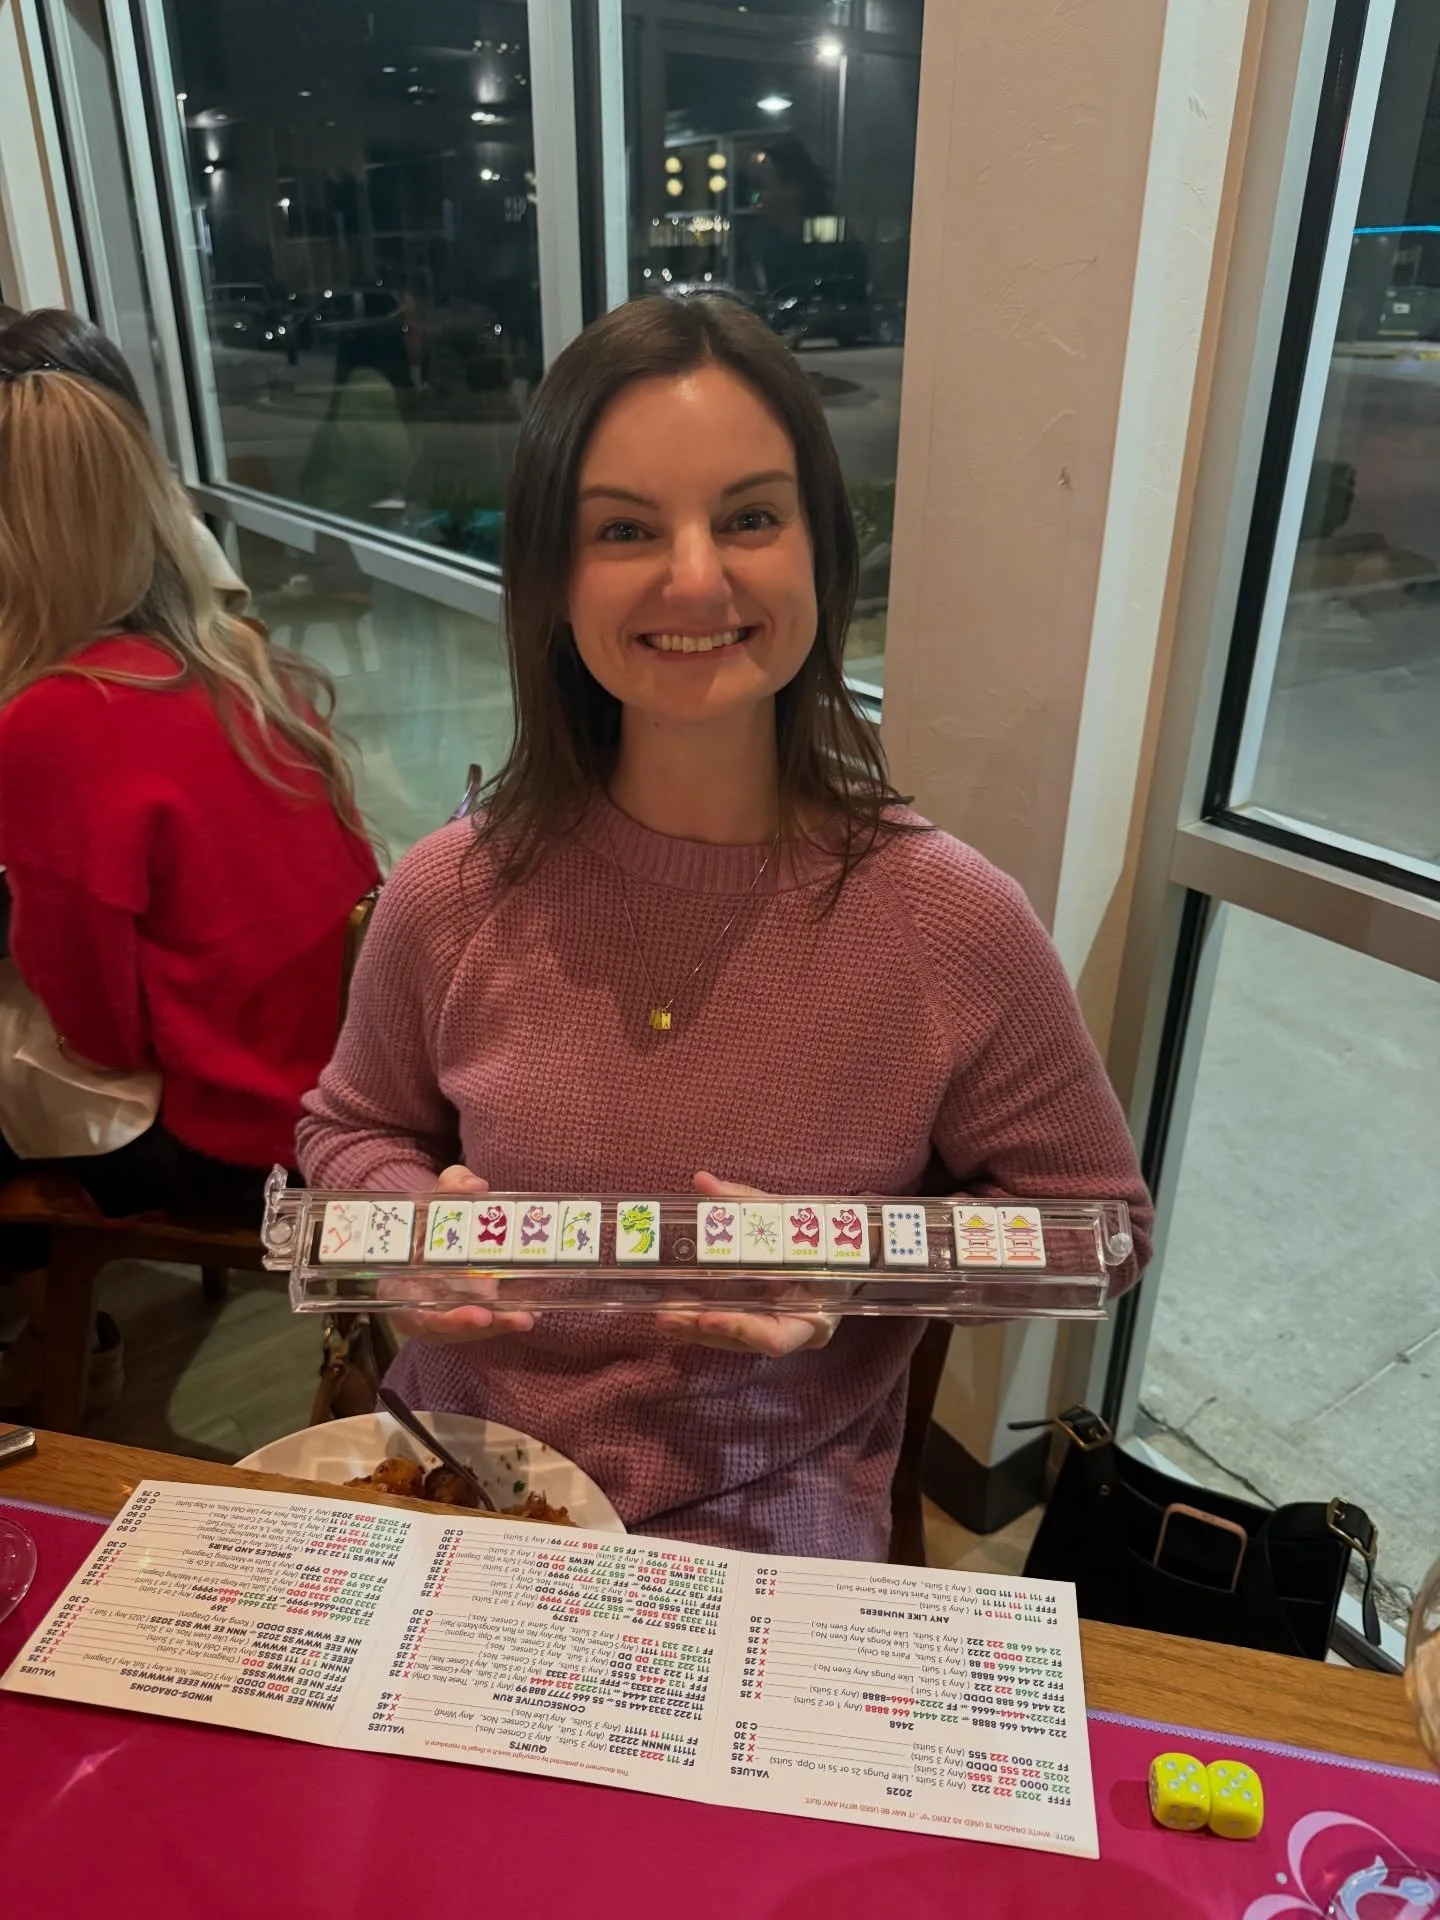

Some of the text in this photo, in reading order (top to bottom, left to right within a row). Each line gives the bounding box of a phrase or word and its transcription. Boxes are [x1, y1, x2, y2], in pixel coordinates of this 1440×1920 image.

[367, 1246, 375, 1254] 4
[791, 1248, 818, 1256] JOKER
[833, 1249, 861, 1258] JOKER
[330, 1511, 354, 1519] 2025
[354, 1514, 376, 1523] 2025
[377, 1518, 400, 1527] 2025
[207, 1542, 293, 1559] SINGLES AND PAIRS
[277, 1560, 295, 1569] (Any
[303, 1565, 321, 1573] 999
[331, 1568, 349, 1577] 666
[358, 1573, 375, 1582] 333
[376, 1576, 388, 1584] FF
[755, 1577, 767, 1585] 30
[836, 1583, 853, 1592] Suit)
[855, 1585, 876, 1594] Same
[889, 1589, 909, 1597] Must
[910, 1591, 929, 1599] Pairs
[959, 1594, 978, 1604] (Any
[993, 1600, 1006, 1608] 111
[210, 1603, 228, 1612] 369
[1008, 1601, 1022, 1610] 111
[1035, 1605, 1056, 1614] FFFF
[552, 1613, 578, 1623] 13579
[859, 1607, 949, 1623] ANY LIKE NUMBERS
[26, 1653, 41, 1662] 25
[19, 1665, 55, 1677] VALUES
[119, 1667, 139, 1677] SSS
[241, 1667, 267, 1678] SSSS
[137, 1670, 175, 1683] WWWW
[175, 1676, 200, 1687] EEEE
[266, 1672, 294, 1683] WWW
[295, 1677, 309, 1686] EE
[199, 1680, 223, 1690] NNN
[308, 1679, 325, 1689] NN
[324, 1683, 343, 1693] FFF
[129, 1682, 213, 1702] WINDS-DRAGONS
[231, 1685, 256, 1696] SSSS
[255, 1689, 284, 1701] WWW
[739, 1690, 752, 1698] 25
[285, 1695, 305, 1705] EEE
[304, 1699, 335, 1711] NNNN
[492, 1692, 586, 1713] CONSECUTIVE RUN
[793, 1695, 816, 1706] Suits)
[843, 1700, 863, 1711] (Any
[864, 1704, 889, 1715] 8888
[372, 1711, 385, 1720] 40
[891, 1707, 910, 1717] 666
[912, 1710, 938, 1720] 4444
[940, 1714, 958, 1723] 222
[971, 1718, 996, 1728] 8888
[367, 1722, 404, 1734] VALUES
[735, 1720, 748, 1729] 30
[889, 1720, 914, 1731] 2468
[999, 1721, 1018, 1731] 666
[1020, 1724, 1046, 1735] 4444
[534, 1731, 552, 1743] Any
[1048, 1728, 1067, 1738] 222
[508, 1740, 547, 1753] QUINTS
[587, 1739, 607, 1751] (Any
[912, 1741, 936, 1753] Suits)
[608, 1744, 639, 1757] 33333
[639, 1749, 665, 1761] 2222
[945, 1745, 965, 1757] (Any
[968, 1750, 987, 1760] 555
[666, 1754, 680, 1764] 111
[682, 1757, 695, 1766] FF
[989, 1752, 1008, 1763] 222
[1011, 1756, 1032, 1766] 000
[1035, 1759, 1054, 1770] 222
[1057, 1763, 1069, 1772] FF
[730, 1766, 769, 1778] VALUES
[886, 1786, 912, 1798] 2025
[822, 1799, 838, 1807] ANY
[839, 1801, 858, 1810] WITH
[859, 1804, 879, 1813] USED
[891, 1809, 906, 1817] MAY
[931, 1814, 951, 1823] ZERO
[963, 1819, 984, 1827] USED
[993, 1823, 1026, 1834] DRAGON
[1027, 1828, 1051, 1838] WHITE
